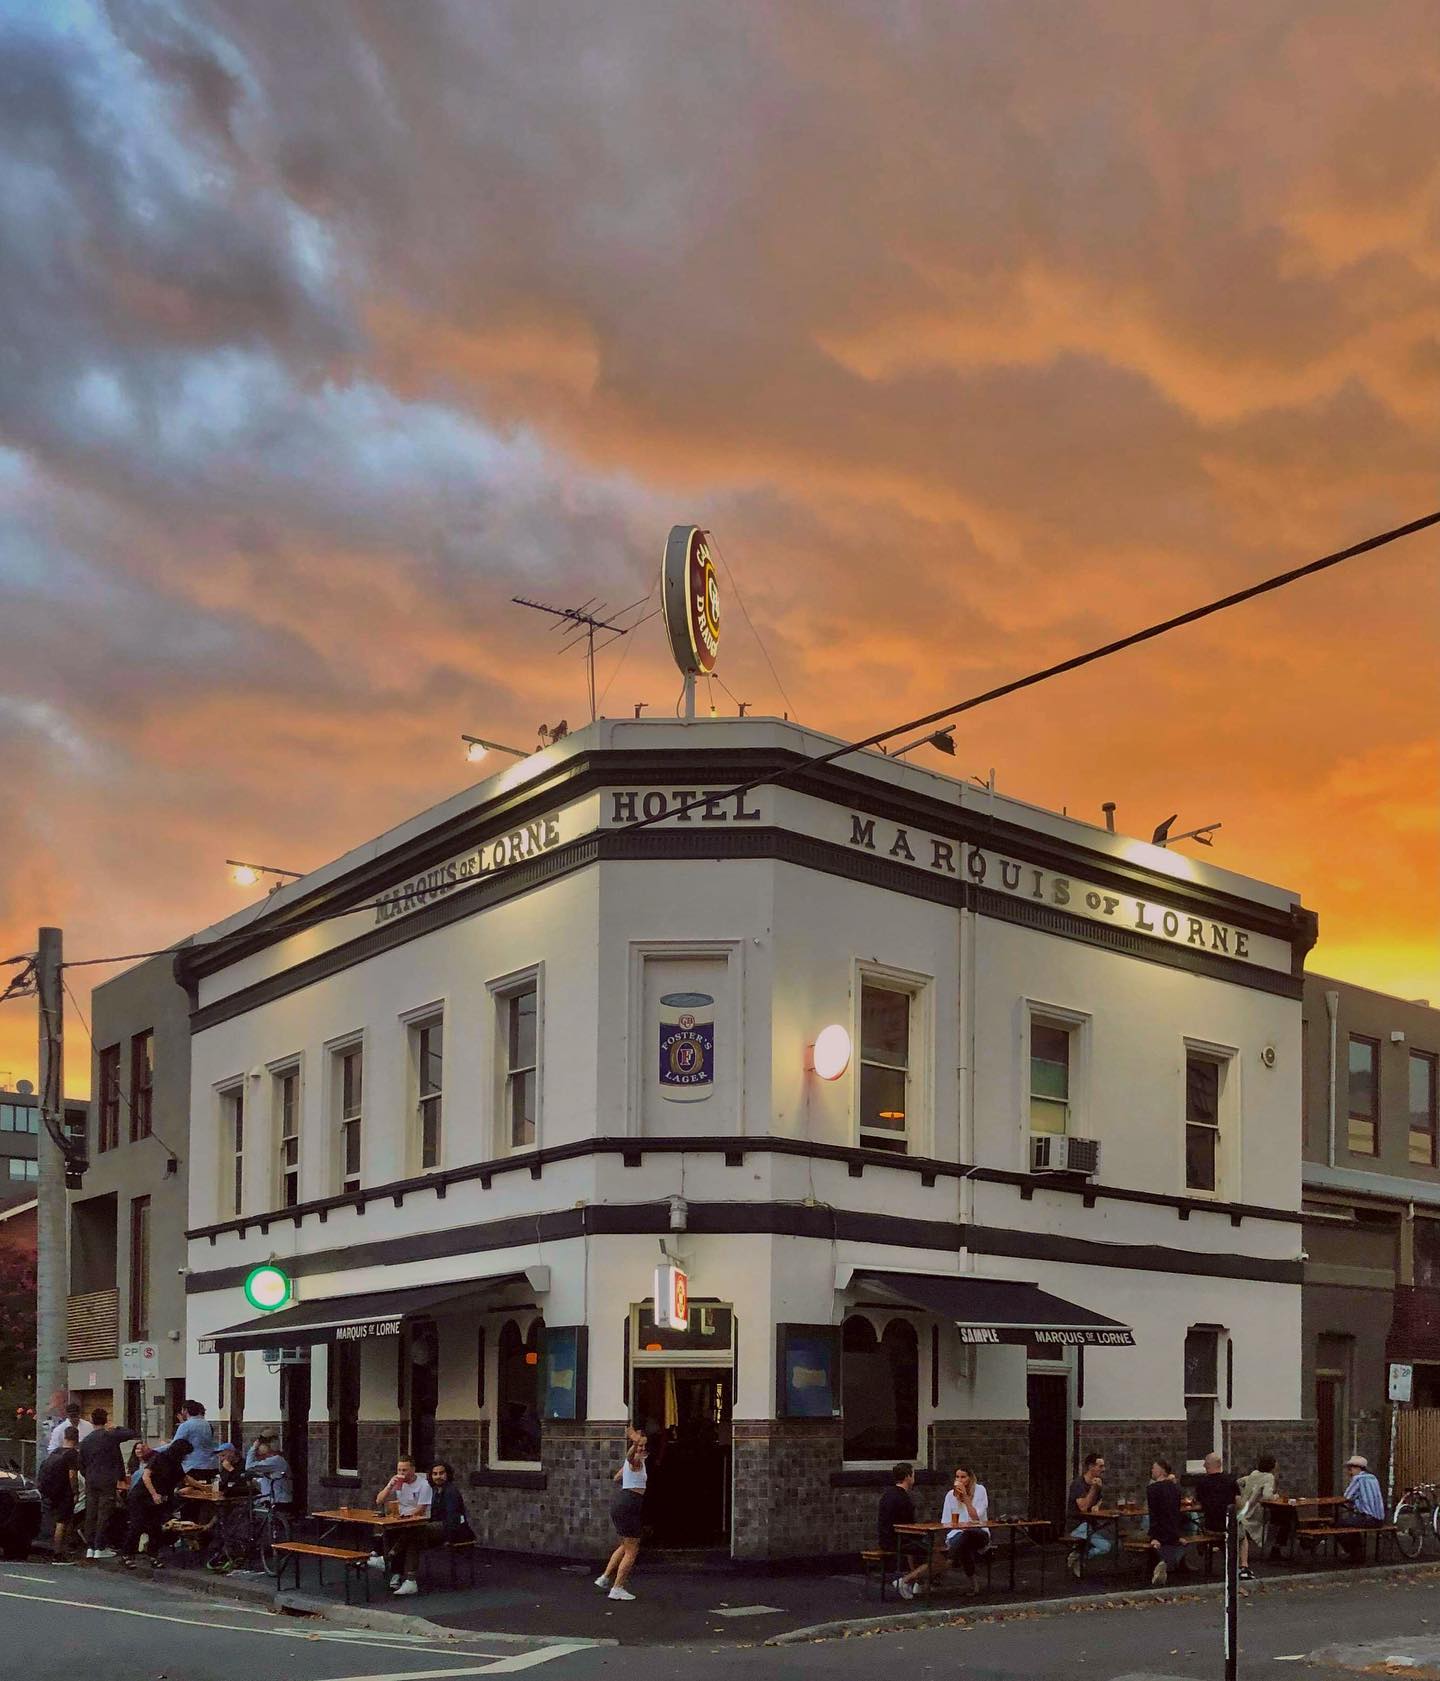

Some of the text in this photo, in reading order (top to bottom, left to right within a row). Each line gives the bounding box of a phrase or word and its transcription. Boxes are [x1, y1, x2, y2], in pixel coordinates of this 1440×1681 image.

[697, 595, 717, 657] DRAUG
[612, 791, 760, 822] HOTEL
[375, 814, 560, 925] MARQUIS OF LORNE
[850, 814, 1249, 958] MARQUIS OF LORNE
[661, 1031, 712, 1051] FOSTER'S
[680, 1048, 693, 1066] F
[665, 1071, 708, 1083] LAGER
[336, 1325, 368, 1341] MARQUIS
[376, 1321, 400, 1336] LORNE
[961, 1328, 1000, 1344] SAMPLE
[1034, 1331, 1085, 1346] MARQUIS
[1097, 1332, 1132, 1344] LORNE
[124, 1347, 138, 1357] 2P
